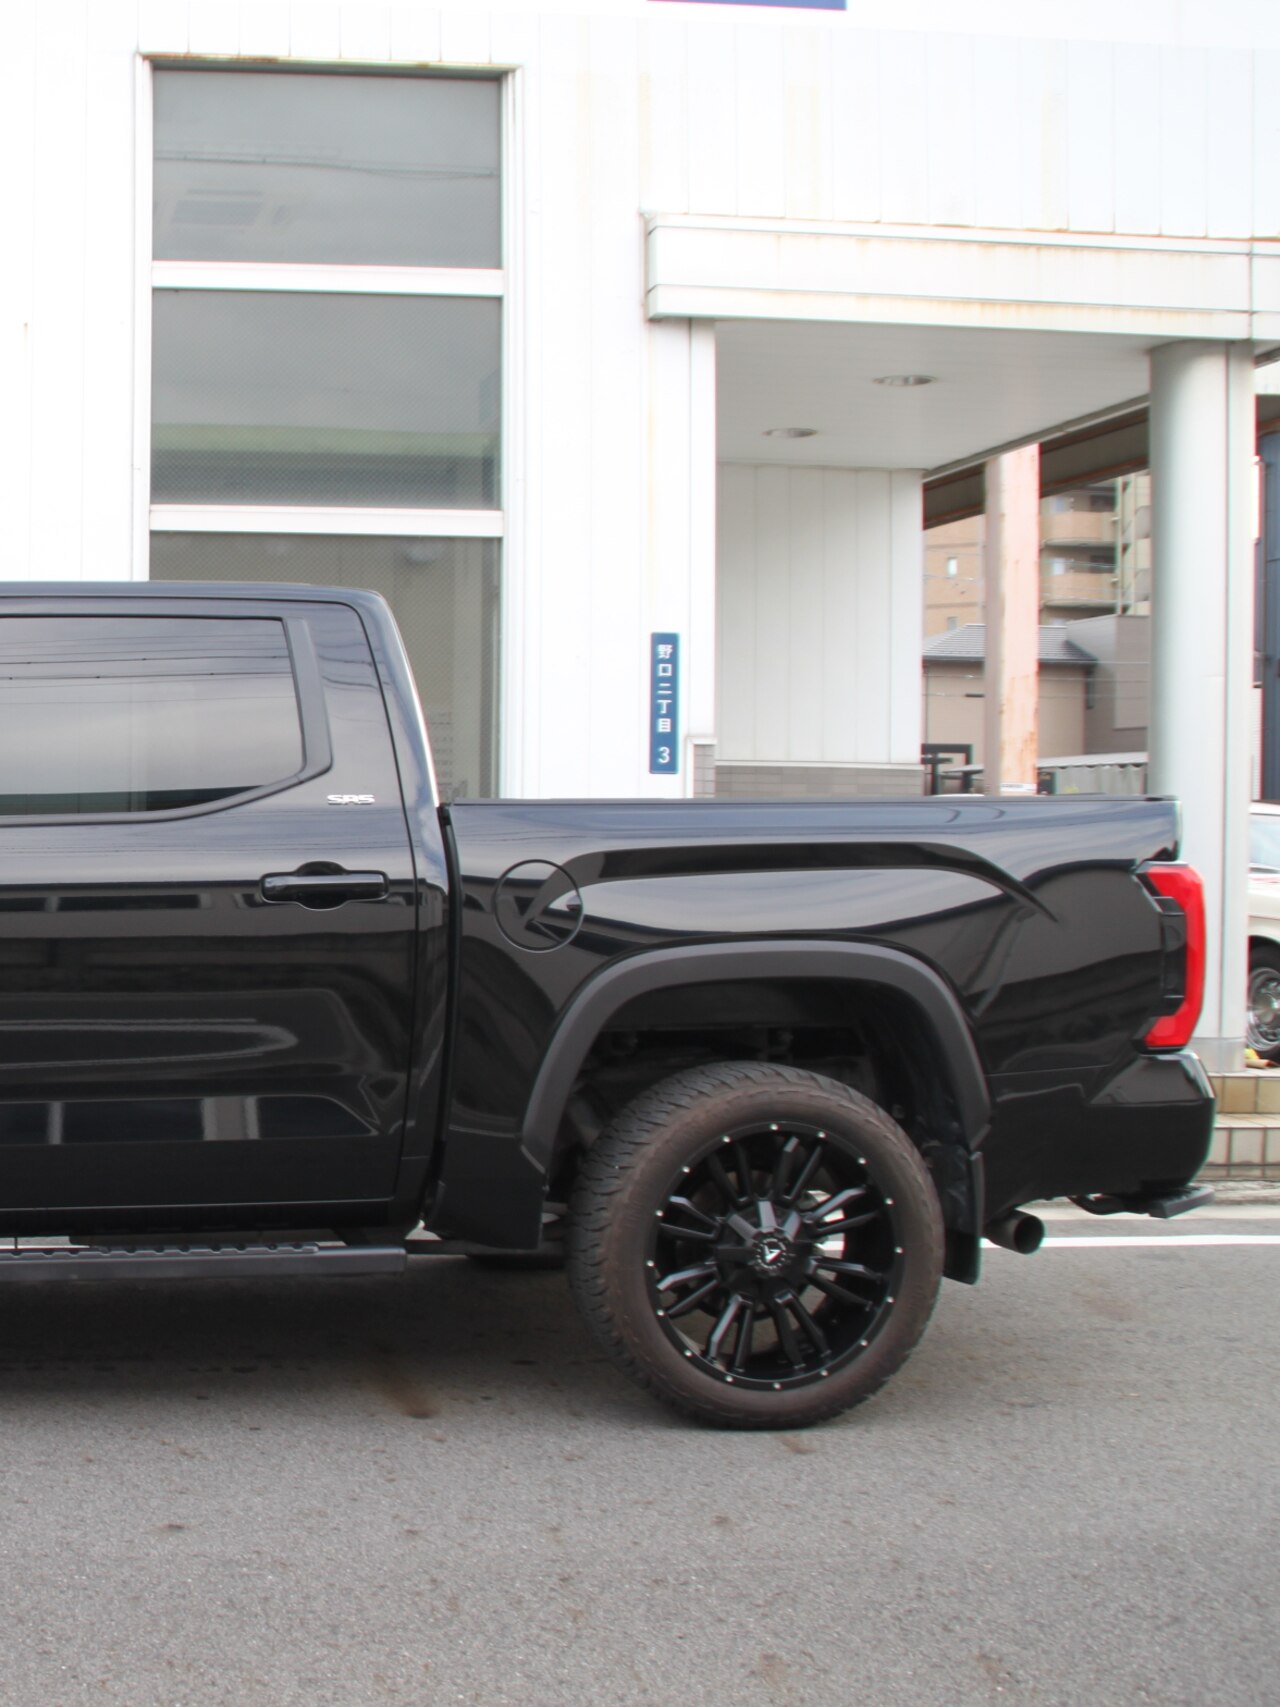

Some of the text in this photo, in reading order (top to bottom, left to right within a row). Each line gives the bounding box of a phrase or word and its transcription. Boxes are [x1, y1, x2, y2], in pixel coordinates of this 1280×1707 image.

[657, 644, 673, 764] 野口二丁目 3
